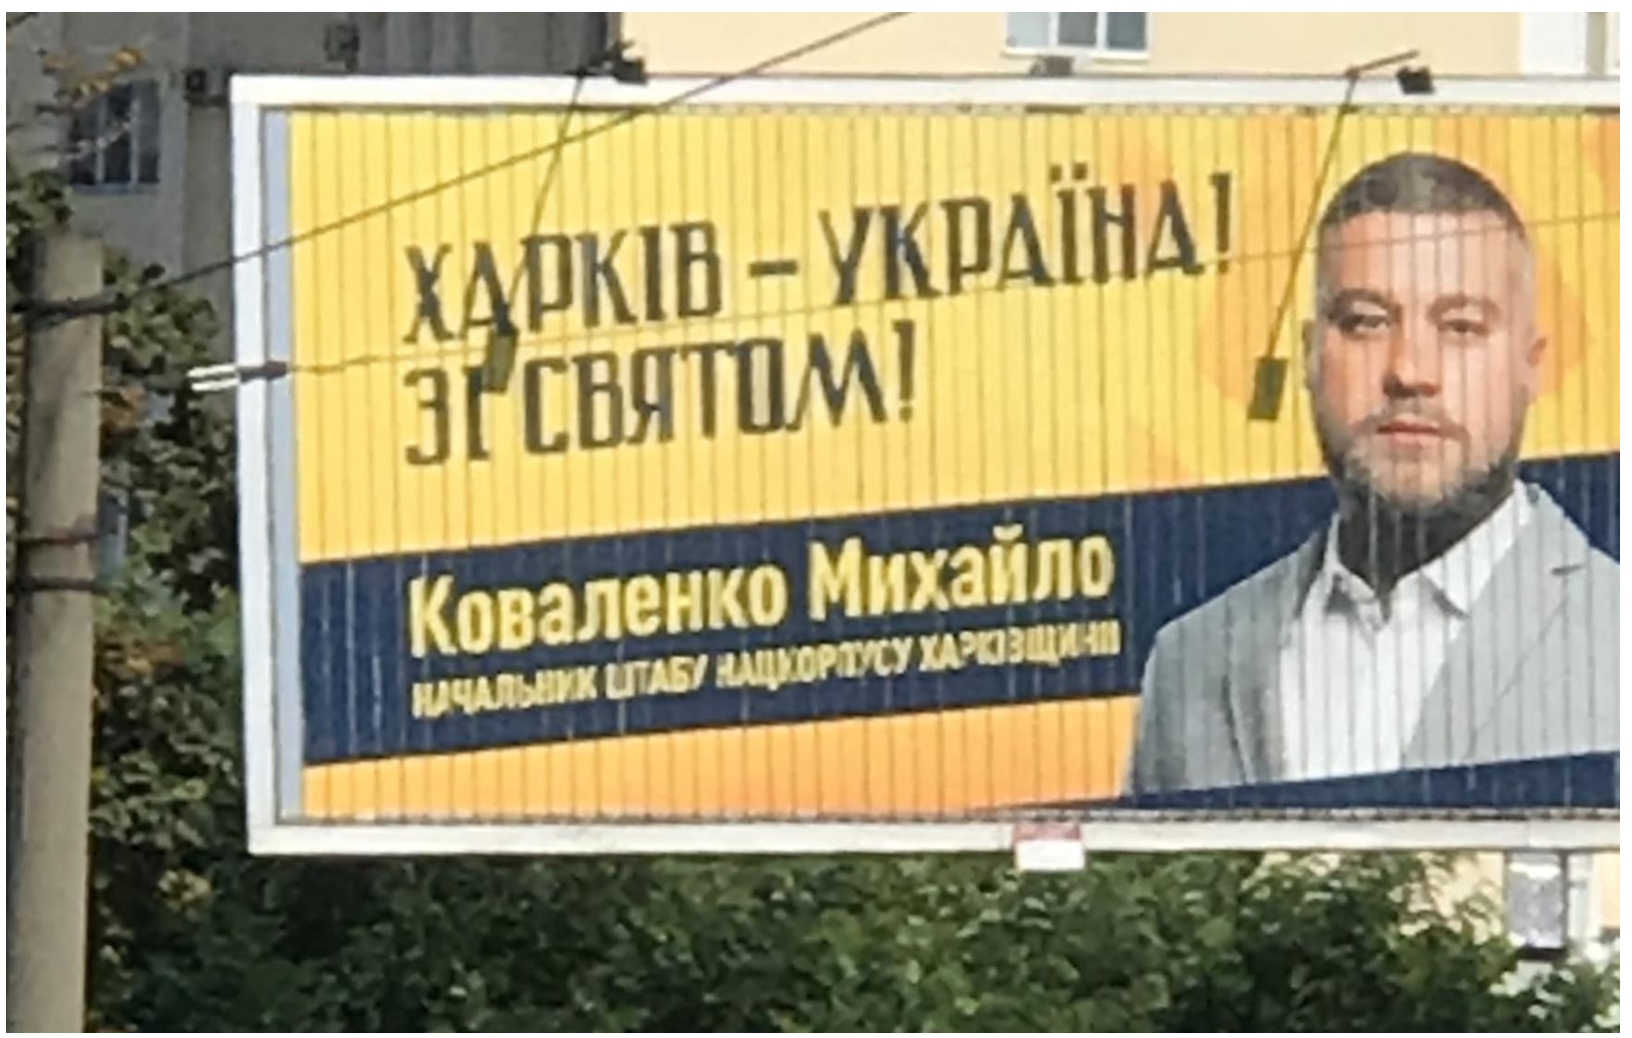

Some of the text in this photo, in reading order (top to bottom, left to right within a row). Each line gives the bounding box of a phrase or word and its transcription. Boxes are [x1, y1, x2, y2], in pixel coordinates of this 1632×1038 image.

[403, 219, 722, 344] ХАРКІВ
[818, 162, 1232, 305] УКРАЇНА!
[404, 319, 916, 466] ЗІ СВЯТОМ!
[409, 522, 1116, 659] Коваленко Михайло
[411, 664, 598, 720] НАЧАЛЬНИК
[604, 653, 709, 701] ШТАБУ
[715, 635, 914, 692] НАЦКОРПУСУ
